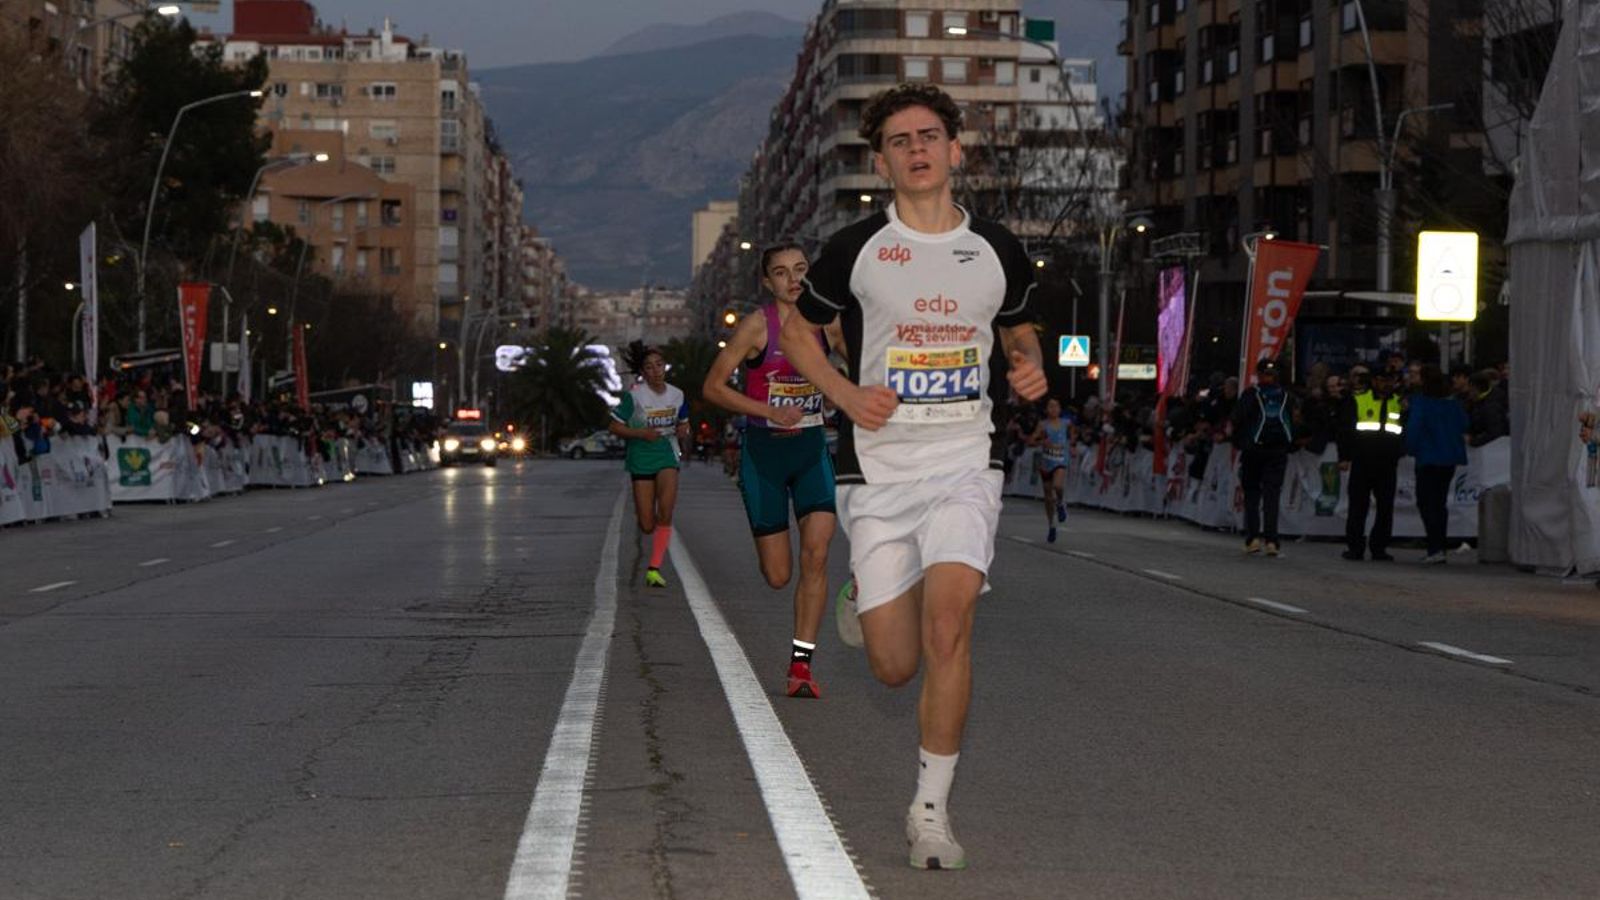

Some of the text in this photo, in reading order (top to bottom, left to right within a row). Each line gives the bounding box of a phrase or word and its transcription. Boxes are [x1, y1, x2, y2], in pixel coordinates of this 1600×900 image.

[878, 243, 912, 267] edp
[914, 294, 958, 315] edp
[890, 367, 980, 394] 10214
